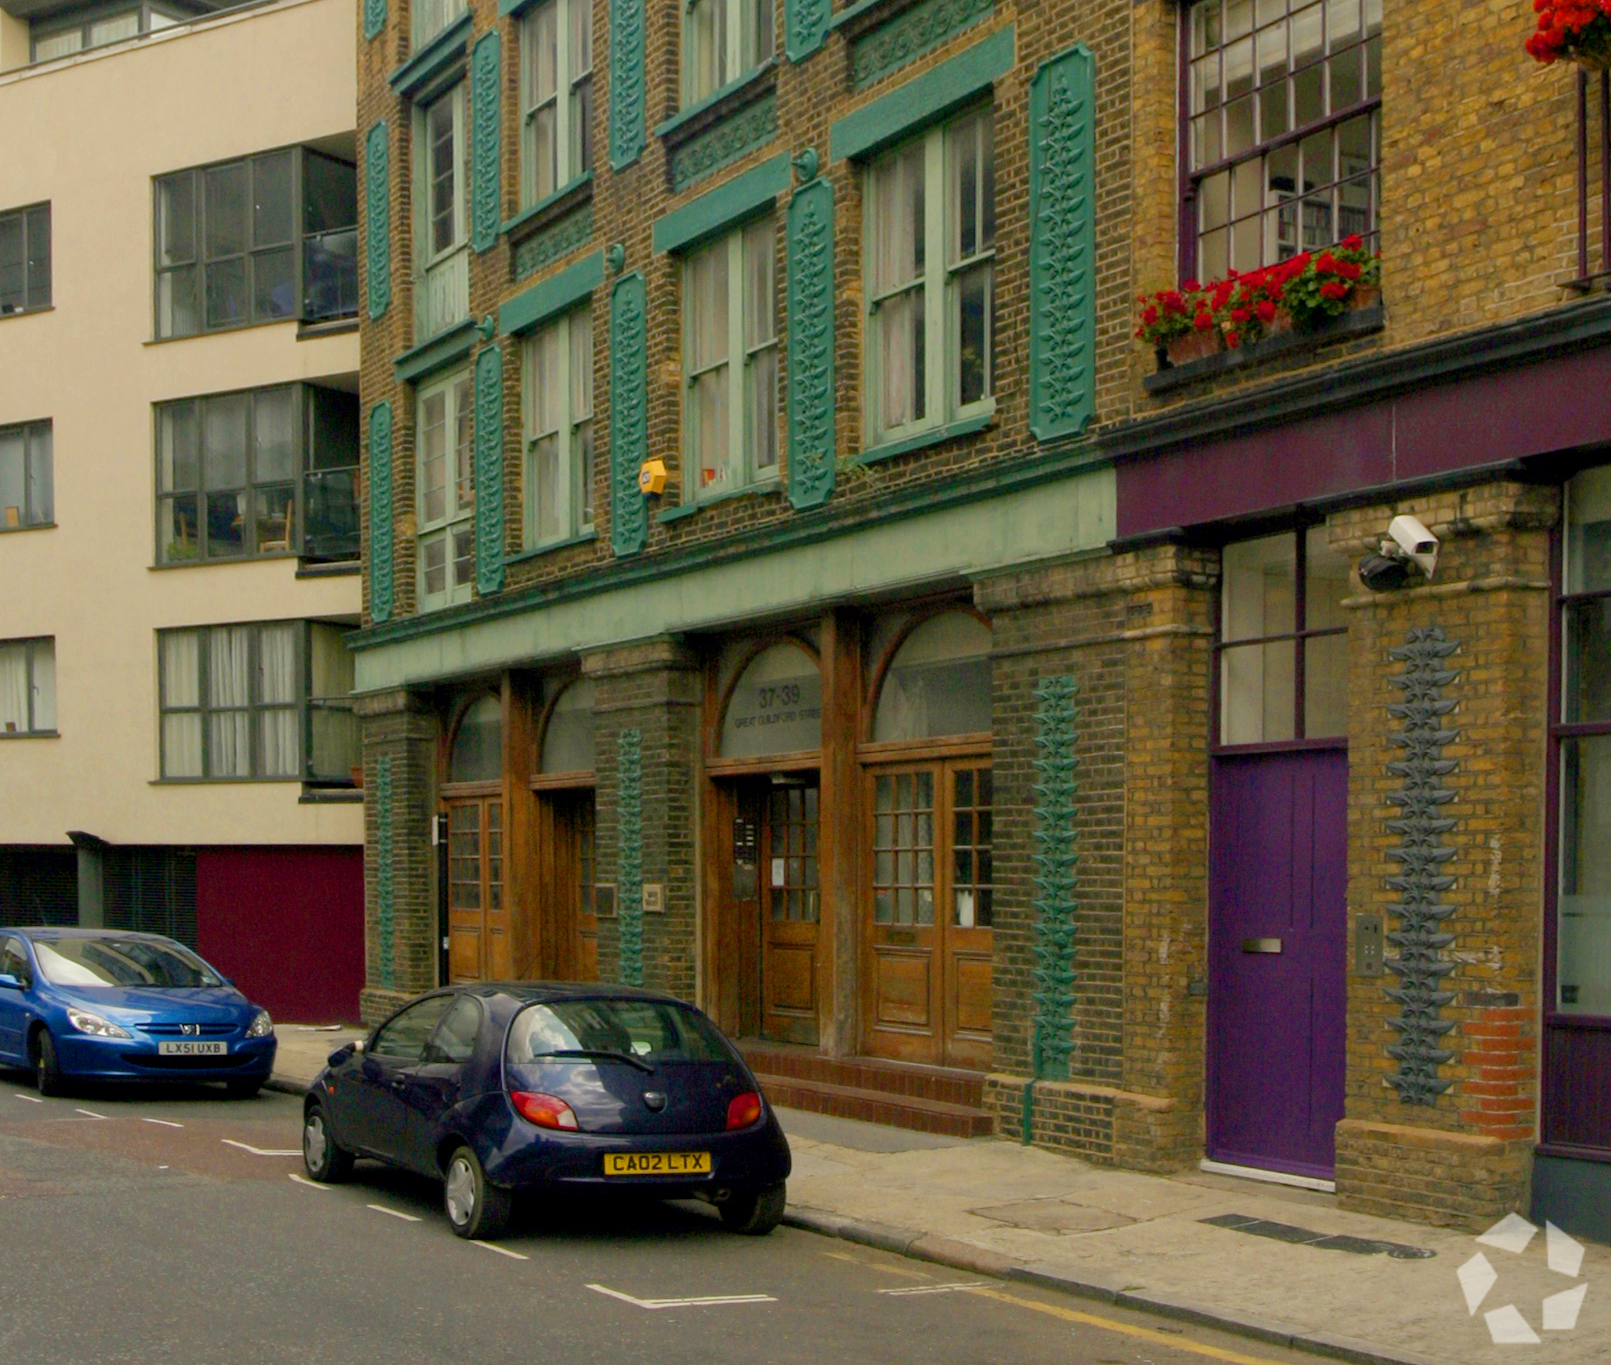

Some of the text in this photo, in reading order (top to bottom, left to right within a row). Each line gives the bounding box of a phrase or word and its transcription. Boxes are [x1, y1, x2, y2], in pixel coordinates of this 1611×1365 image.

[759, 684, 801, 709] 37-39
[798, 707, 822, 721] STREE
[166, 1043, 221, 1054] LX51 UXB
[612, 1154, 703, 1171] CA02 LTX
